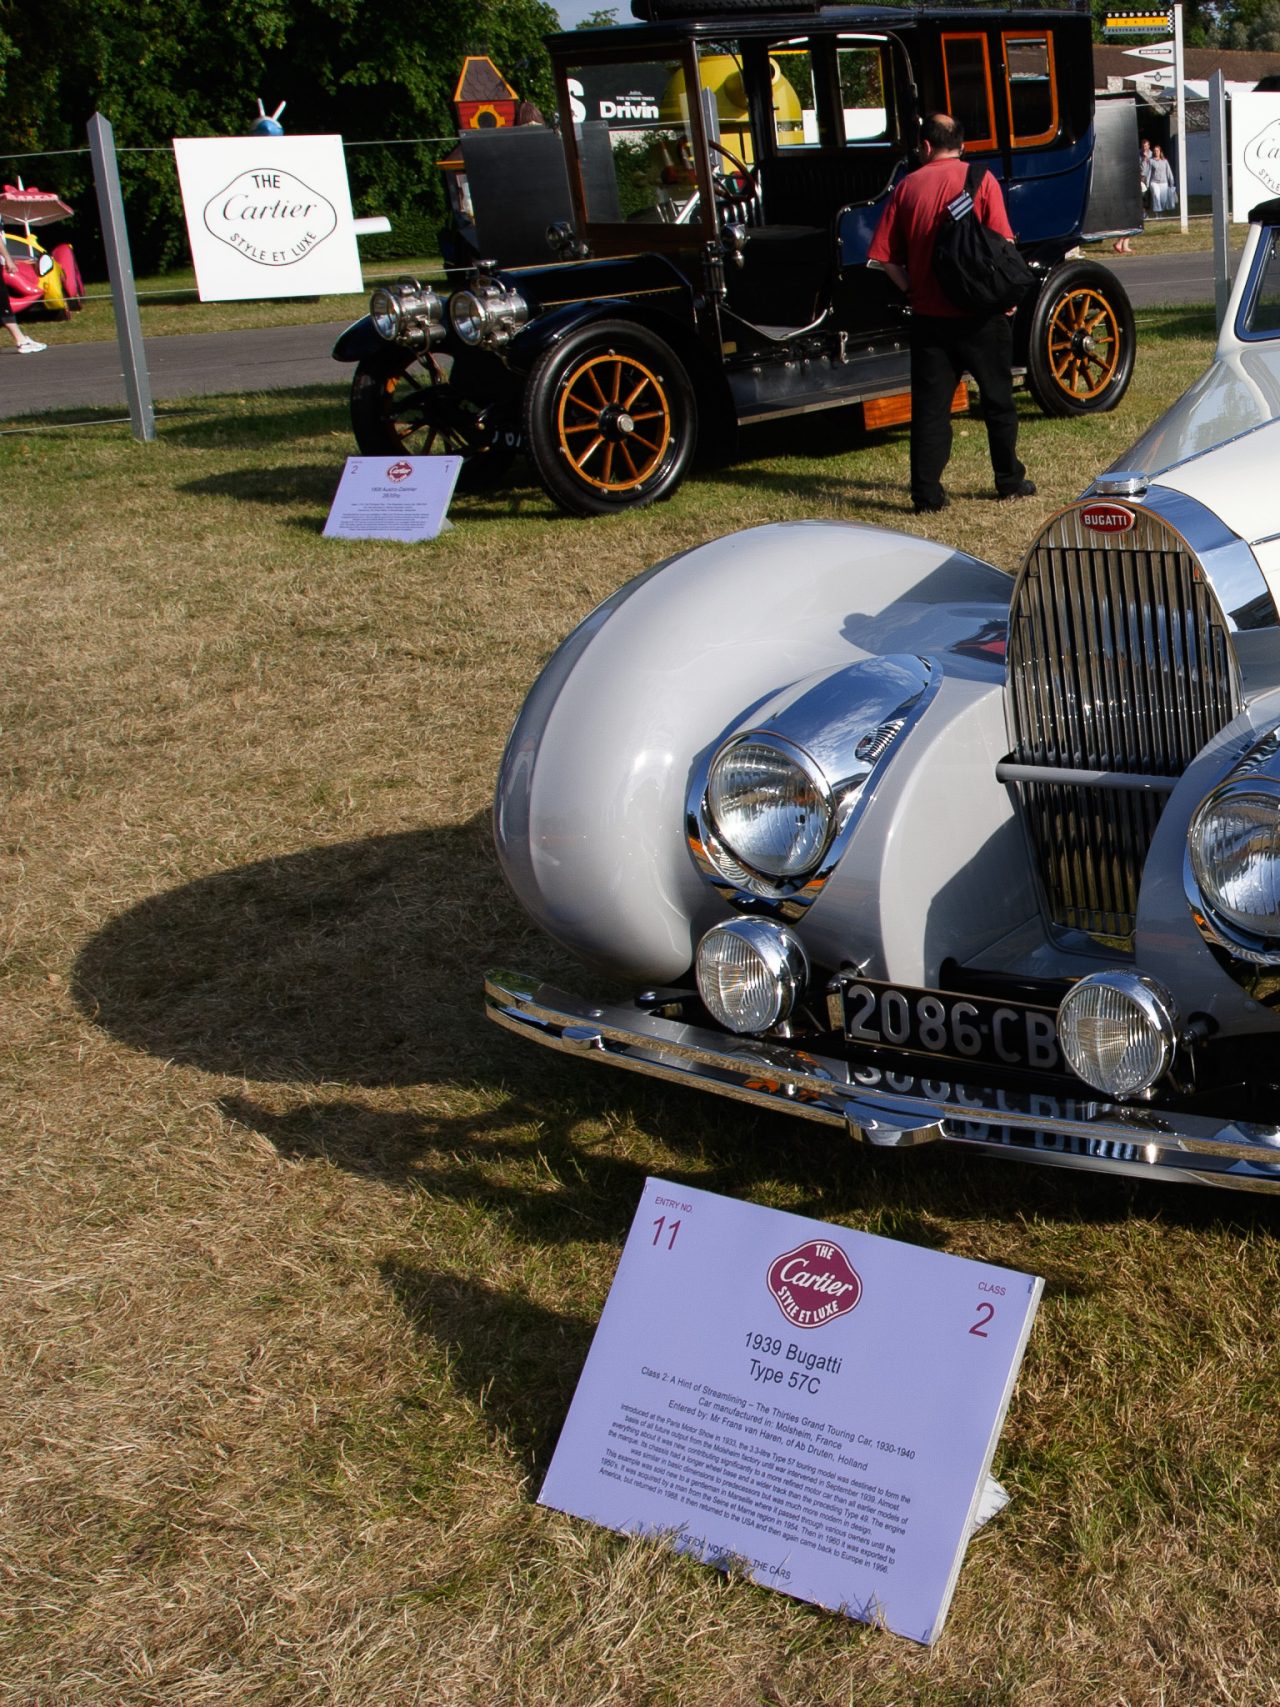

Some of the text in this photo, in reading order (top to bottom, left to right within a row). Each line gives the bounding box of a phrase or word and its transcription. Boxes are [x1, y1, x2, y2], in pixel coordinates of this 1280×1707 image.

[252, 174, 280, 188] THE
[1259, 168, 1280, 192] STYLE
[223, 194, 317, 221] Cartier
[230, 231, 317, 262] STYLE ET LUXE
[1084, 514, 1127, 526] BUGATTI
[654, 1196, 693, 1213] ENTRY NO.
[651, 1215, 681, 1251] 11
[815, 1245, 834, 1260] THE
[780, 1258, 853, 1296] Cartier
[978, 1282, 1006, 1296] CLASS
[777, 1286, 839, 1323] STYLE ET LUXE
[968, 1302, 994, 1338] 2
[742, 1332, 842, 1374] 1939 Bugatti
[750, 1358, 821, 1394] Type 57C
[641, 1367, 661, 1379] Class
[661, 1373, 670, 1382] 2:
[669, 1376, 676, 1384] A
[677, 1378, 693, 1389] Hint
[693, 1384, 702, 1392] of
[702, 1386, 748, 1408] Streamlining
[756, 1402, 770, 1414] The
[773, 1407, 800, 1423] Thirties
[801, 1417, 826, 1431] Grand
[827, 1424, 856, 1442] Touring
[857, 1435, 873, 1448] Car,
[875, 1441, 915, 1459] 1930-1940
[698, 1397, 843, 1450] Car manufactured in: Molsheim, France
[620, 1403, 650, 1418] Introduced
[656, 1415, 666, 1423] the
[666, 1418, 681, 1428] Paris
[681, 1423, 698, 1434] Motor
[698, 1429, 715, 1439] Show
[721, 1436, 737, 1448] 1933,
[739, 1442, 748, 1450] the
[749, 1445, 771, 1458] 3.3-litre
[772, 1452, 786, 1463] Type
[796, 1461, 817, 1474] touring
[817, 1469, 837, 1480] model
[837, 1475, 850, 1484] was
[850, 1479, 877, 1493] destined
[885, 1490, 899, 1500] form
[900, 1495, 911, 1504] the
[668, 1400, 868, 1471] Entered by: Mr Frans van Haren, of Ab Druten, Holland
[753, 1559, 769, 1572] THE
[769, 1566, 791, 1580] CARS
